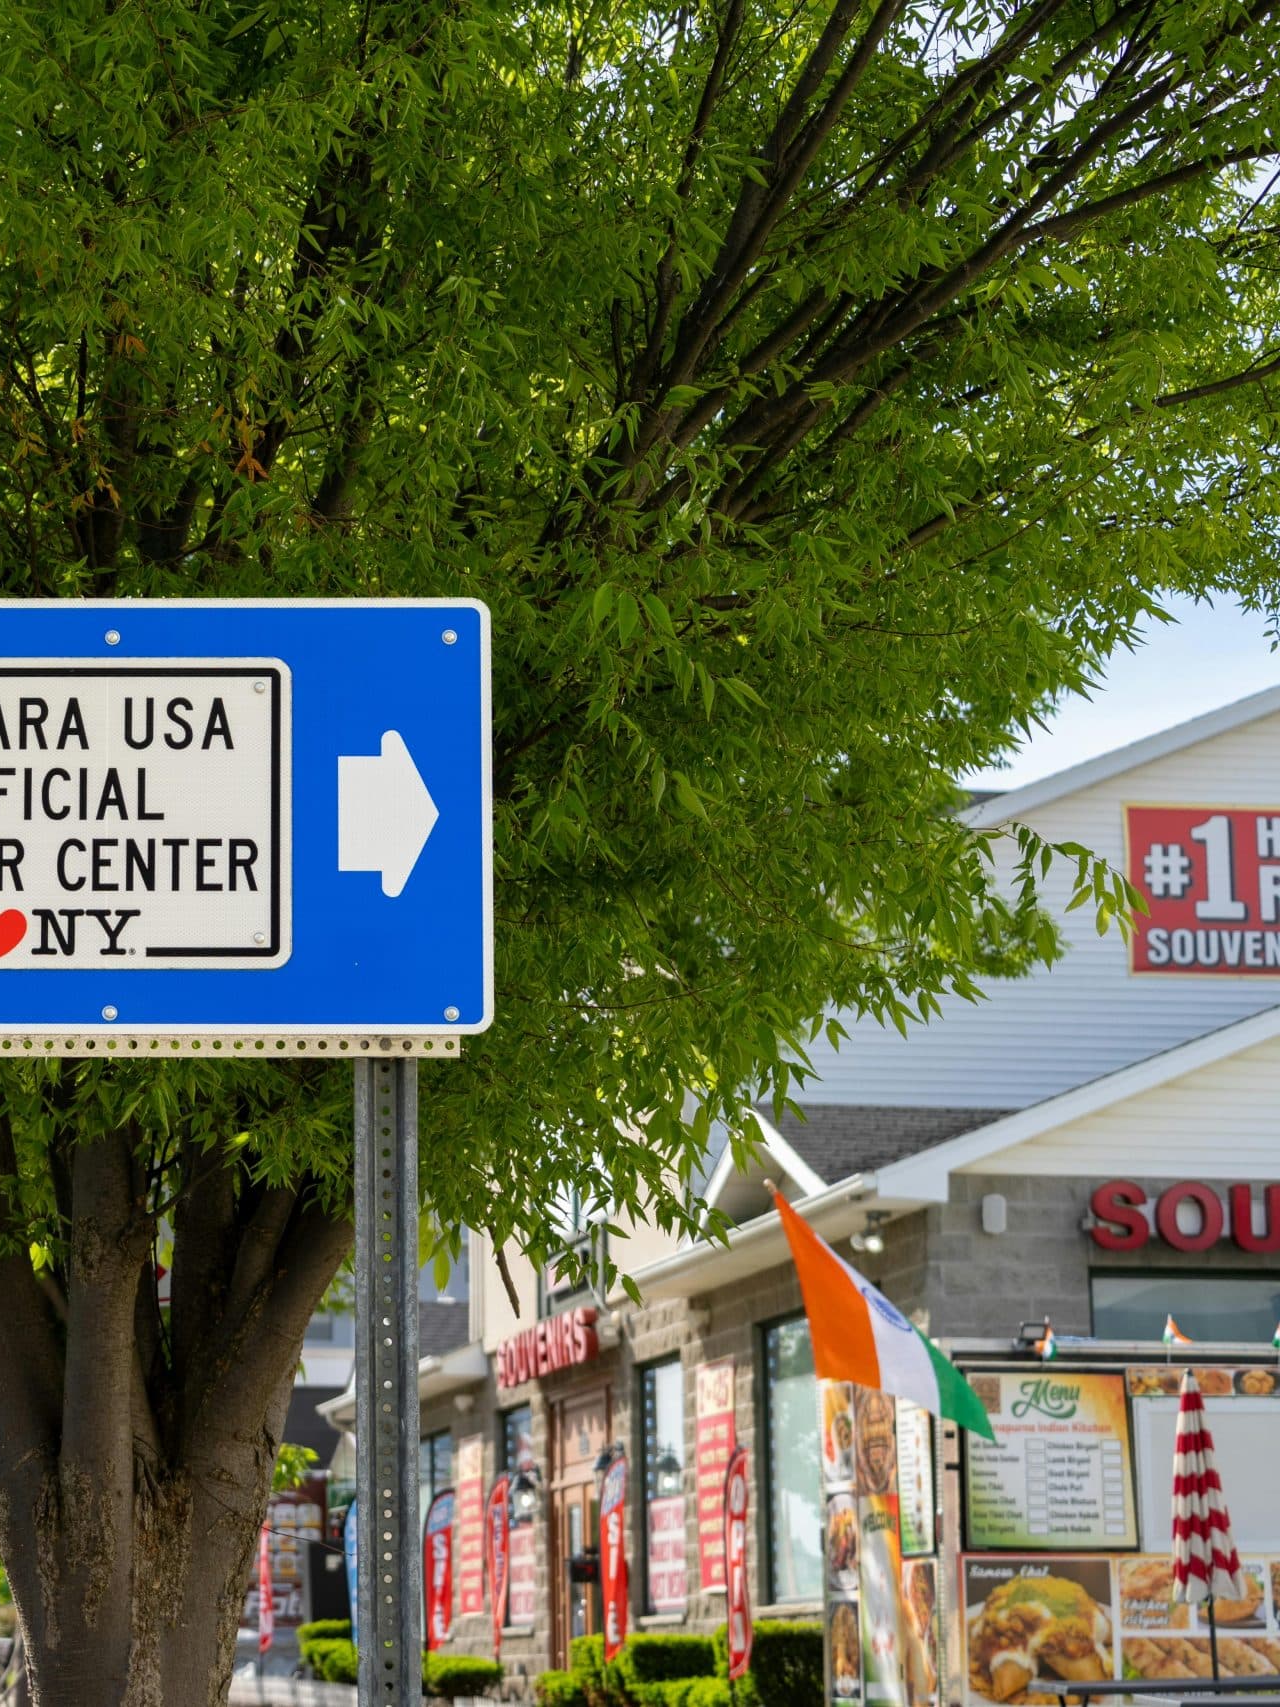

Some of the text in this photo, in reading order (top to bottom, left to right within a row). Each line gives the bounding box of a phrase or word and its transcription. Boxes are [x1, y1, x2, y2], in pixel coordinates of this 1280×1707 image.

[125, 698, 233, 749] USA
[57, 839, 258, 891] CENTER
[1145, 815, 1246, 920] #1
[1011, 1378, 1080, 1420] Menu
